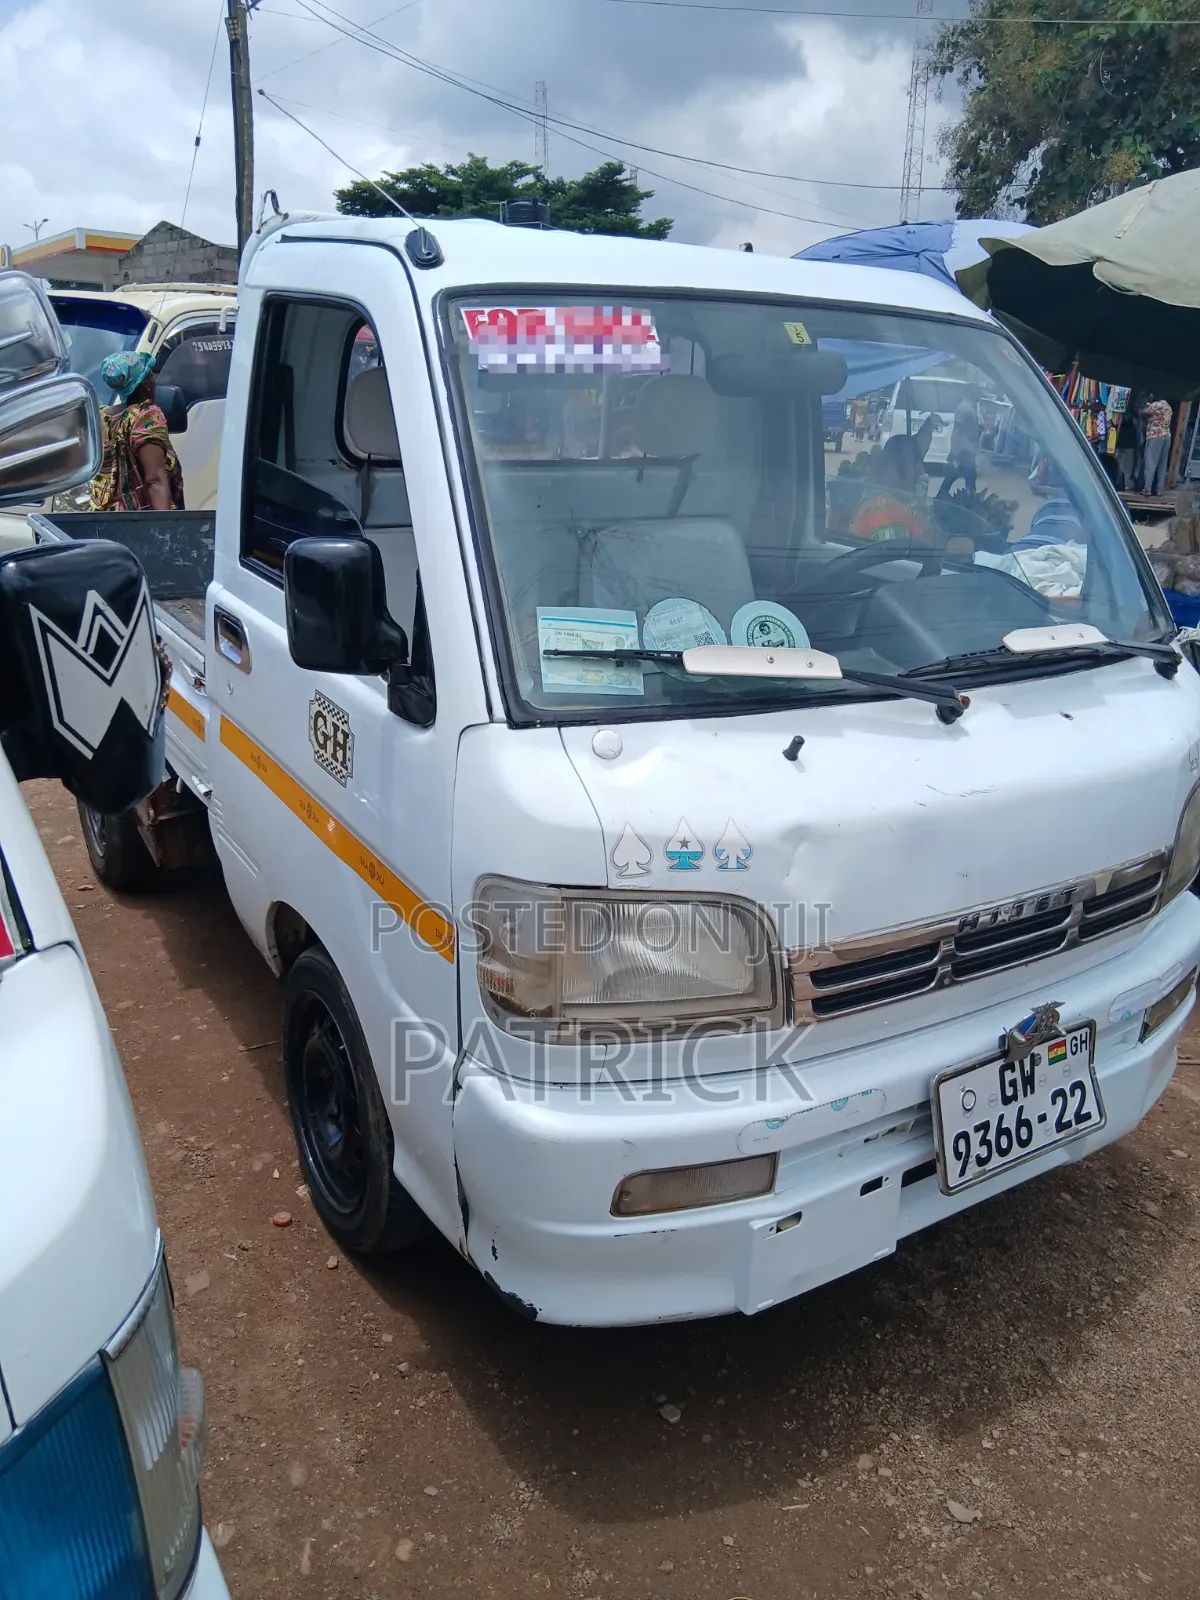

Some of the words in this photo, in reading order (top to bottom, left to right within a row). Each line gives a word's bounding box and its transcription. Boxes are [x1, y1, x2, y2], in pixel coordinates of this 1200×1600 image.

[313, 710, 350, 771] GH
[1069, 1031, 1088, 1056] GH
[999, 1052, 1036, 1106] GW
[953, 1079, 1092, 1178] 9366-22
